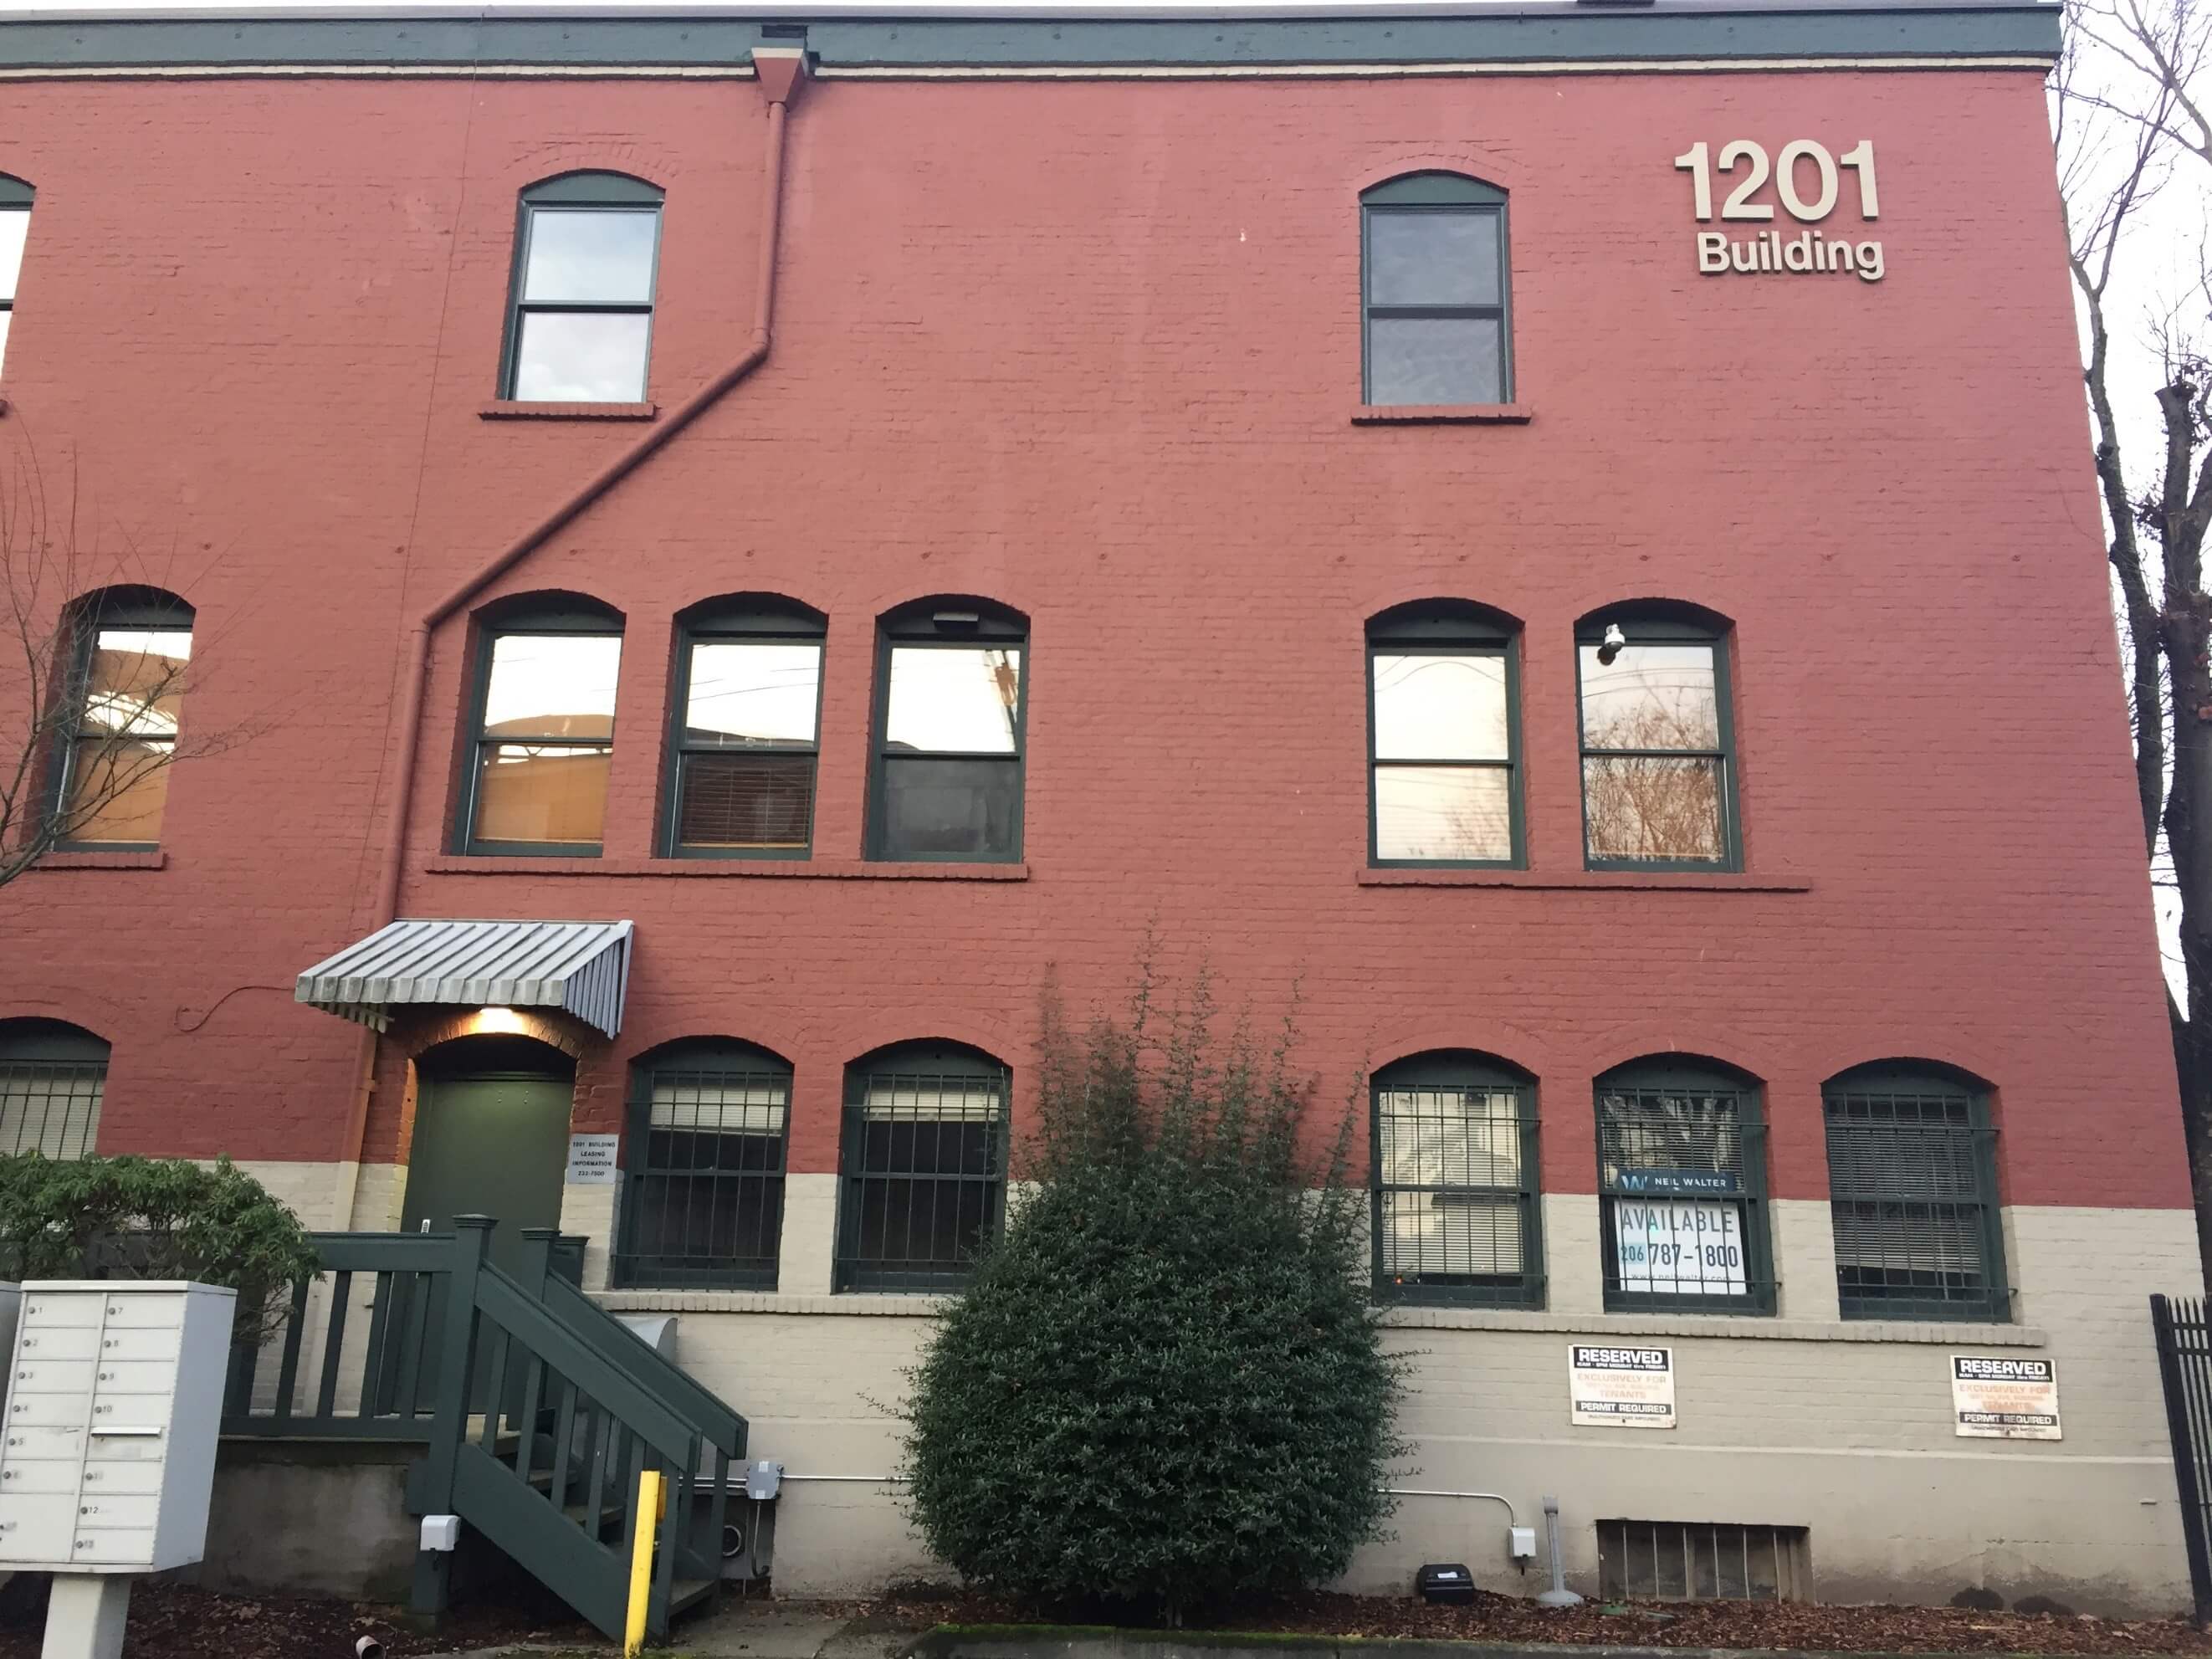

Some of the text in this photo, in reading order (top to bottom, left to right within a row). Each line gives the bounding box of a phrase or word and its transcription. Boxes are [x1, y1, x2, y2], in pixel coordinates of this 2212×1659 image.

[1675, 139, 1879, 222] 1201
[1697, 230, 1885, 281] Building
[1655, 1177, 1727, 1187] NEIL WALTER
[1621, 1208, 1734, 1233] AVAILABLE
[1579, 1349, 1663, 1365] RESERVED
[1960, 1359, 2046, 1375] RESERVED
[1580, 1402, 1667, 1413] PERMIT REQUIRED
[1964, 1414, 2052, 1425] PERMIT REQUIRED
